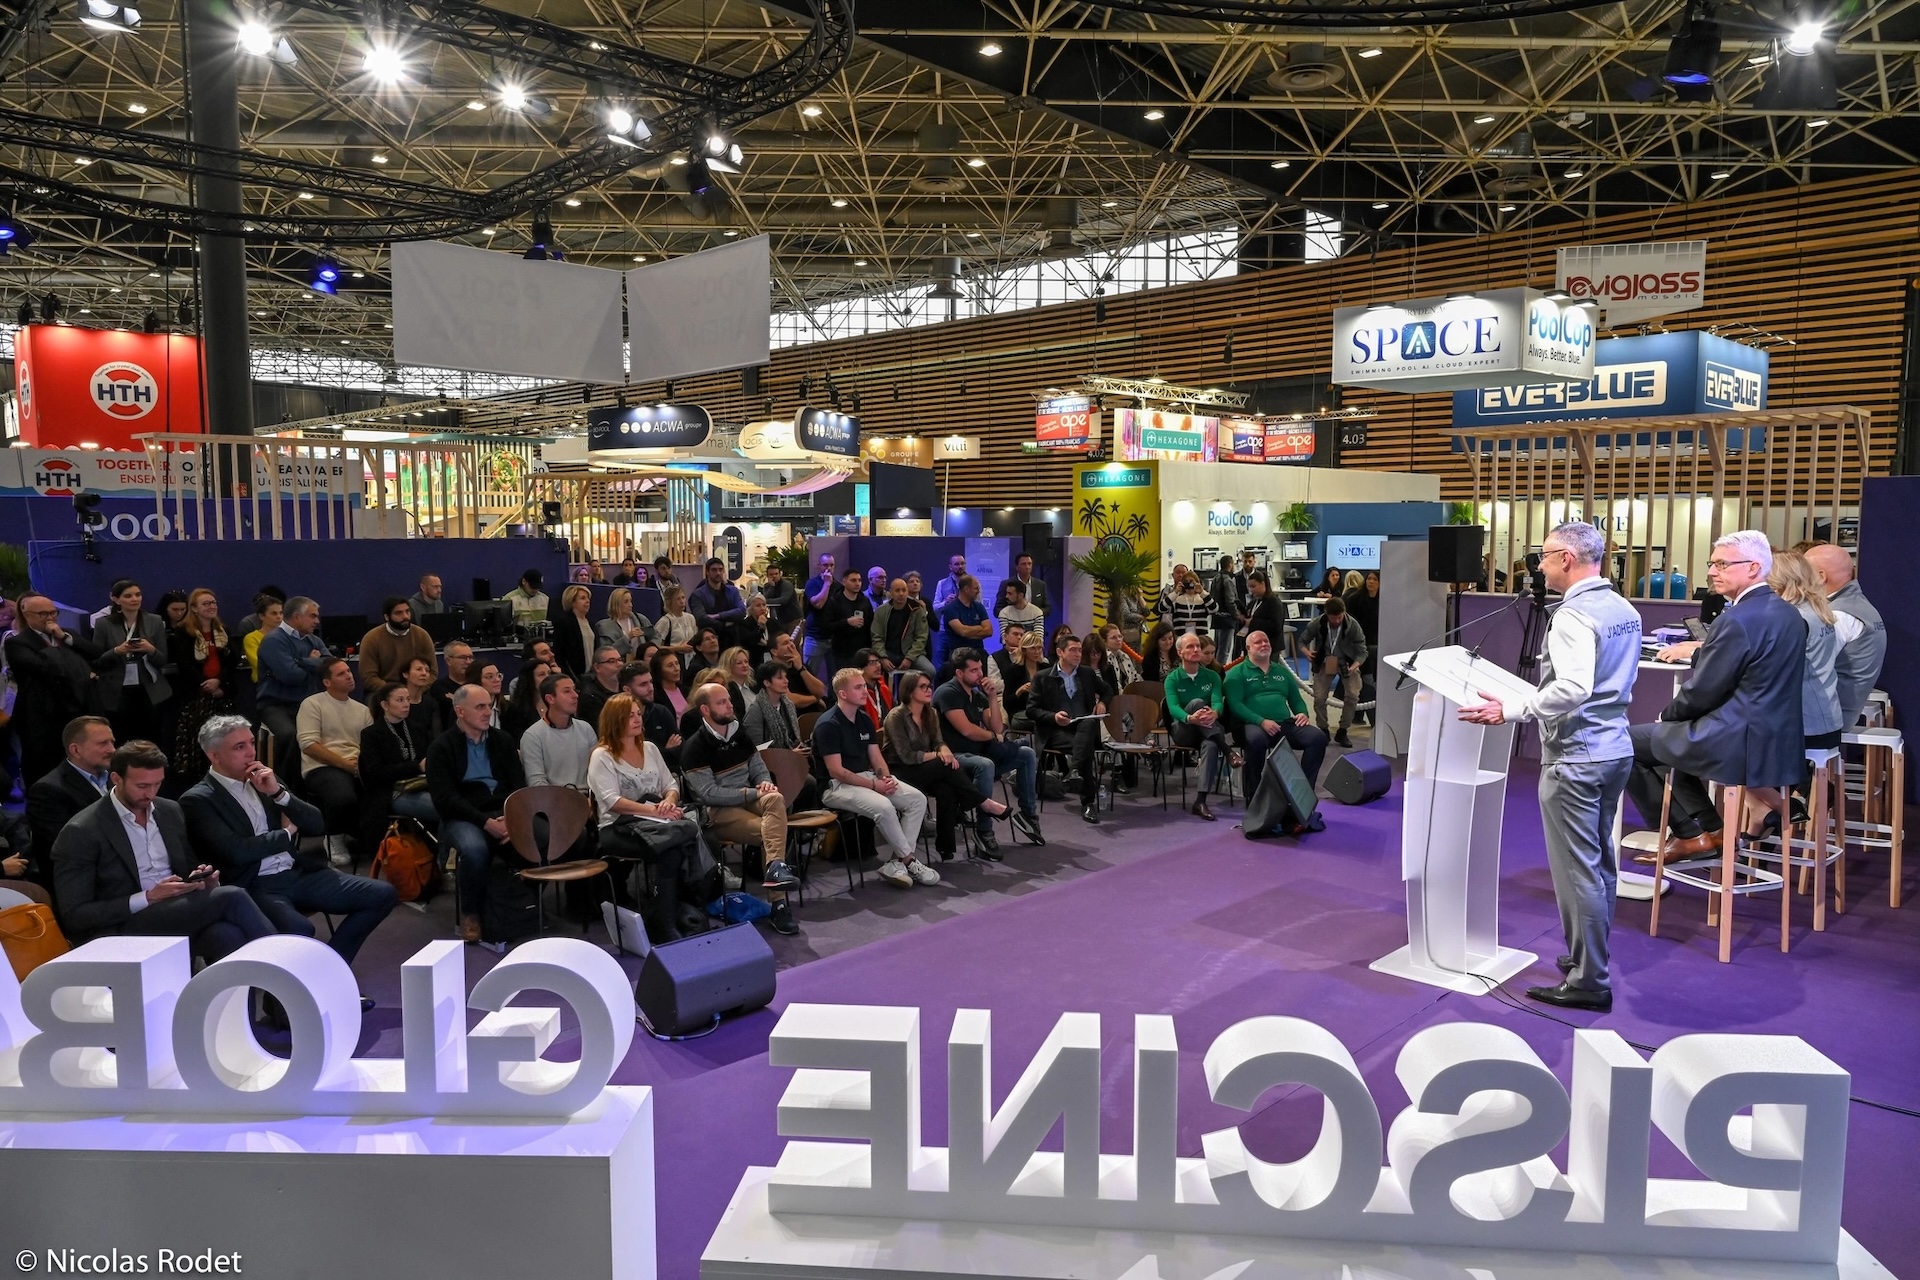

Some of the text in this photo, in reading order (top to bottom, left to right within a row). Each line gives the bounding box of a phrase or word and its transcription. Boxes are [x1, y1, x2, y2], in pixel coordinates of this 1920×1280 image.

[1566, 272, 1700, 301] reviglass
[1529, 303, 1592, 356] PoolCop
[1351, 316, 1501, 364] SPACE
[1528, 344, 1581, 364] Always. Better. Blue.
[1351, 367, 1392, 375] SWIMMING
[1468, 358, 1501, 366] EXPERT
[97, 384, 151, 403] HTH
[1484, 369, 1655, 408] EVERBLUE
[1707, 369, 1758, 407] EVERBLUE
[653, 421, 702, 433] ACWA groupe
[825, 426, 842, 440] ACWA
[1060, 414, 1087, 437] ape
[1158, 436, 1198, 447] HEXAGONE
[1247, 436, 1264, 454] ape
[1287, 435, 1312, 454] ape
[1342, 434, 1365, 445] 4.03
[890, 451, 919, 459] GROUPE
[1088, 449, 1105, 458] 4.02
[36, 472, 81, 487] HTH
[1098, 474, 1145, 483] HEXAGONE
[1208, 510, 1253, 531] PoolCop
[1338, 547, 1376, 556] SPACE
[1607, 619, 1641, 639] J'ADHÈRE
